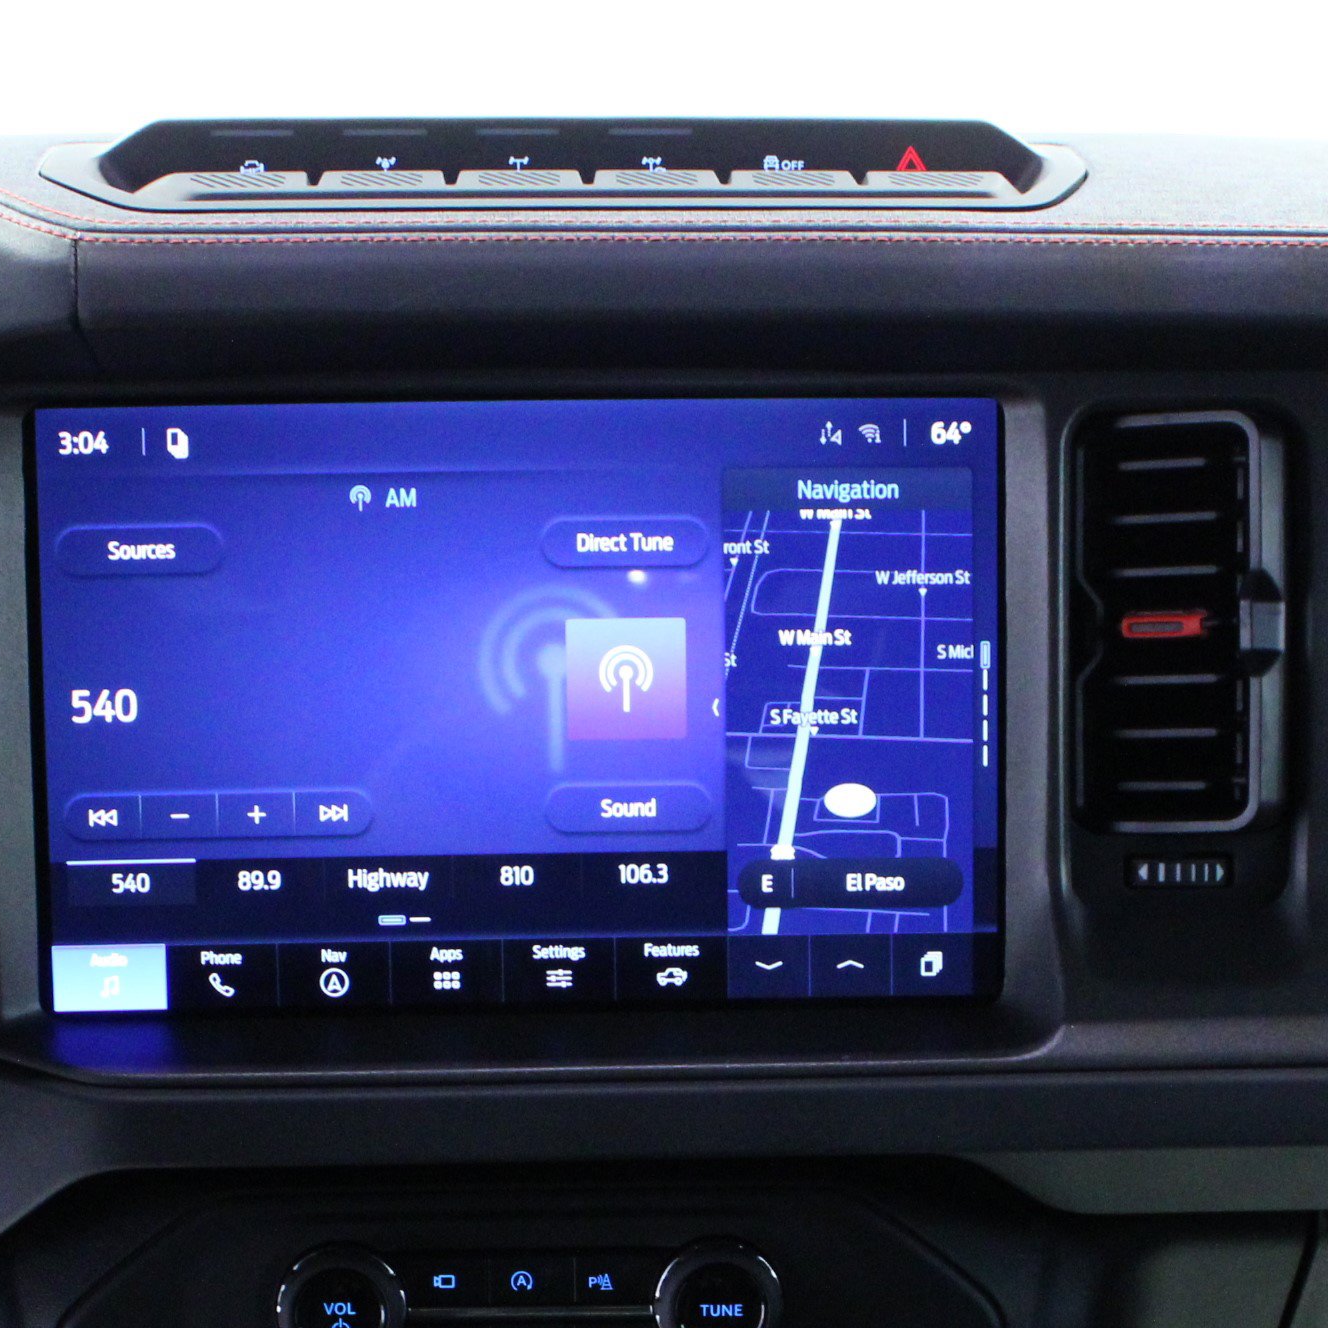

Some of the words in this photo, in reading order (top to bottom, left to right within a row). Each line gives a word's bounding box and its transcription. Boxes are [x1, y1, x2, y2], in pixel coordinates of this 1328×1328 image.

[781, 160, 805, 171] OFF
[58, 431, 109, 455] 3:04
[385, 487, 417, 508] AM
[797, 480, 900, 502] Navigation
[107, 541, 176, 561] Sources
[576, 533, 627, 552] Direct
[630, 532, 674, 552] Tune
[875, 571, 890, 585] W
[892, 571, 953, 586] Jefferson
[955, 570, 971, 585] St
[778, 630, 796, 646] W
[796, 630, 832, 646] Main
[833, 629, 853, 646] St
[71, 689, 138, 724] 540
[770, 710, 781, 726] S
[783, 709, 839, 728] Fayette
[841, 709, 858, 725] St
[600, 799, 657, 818] Sound
[111, 873, 151, 894] 540
[238, 871, 282, 891] 89.9
[347, 868, 430, 892] Highway
[500, 866, 534, 886] 810
[618, 864, 669, 885] 106.3
[761, 875, 773, 893] E
[846, 873, 862, 892] El
[865, 873, 906, 893] Paso
[200, 950, 243, 966] Phone
[321, 949, 348, 964] Nav
[430, 946, 463, 964] Apps
[532, 944, 586, 961] Settings
[644, 942, 700, 959] Features
[323, 1302, 356, 1316] VOL
[700, 1303, 743, 1317] TUNE
